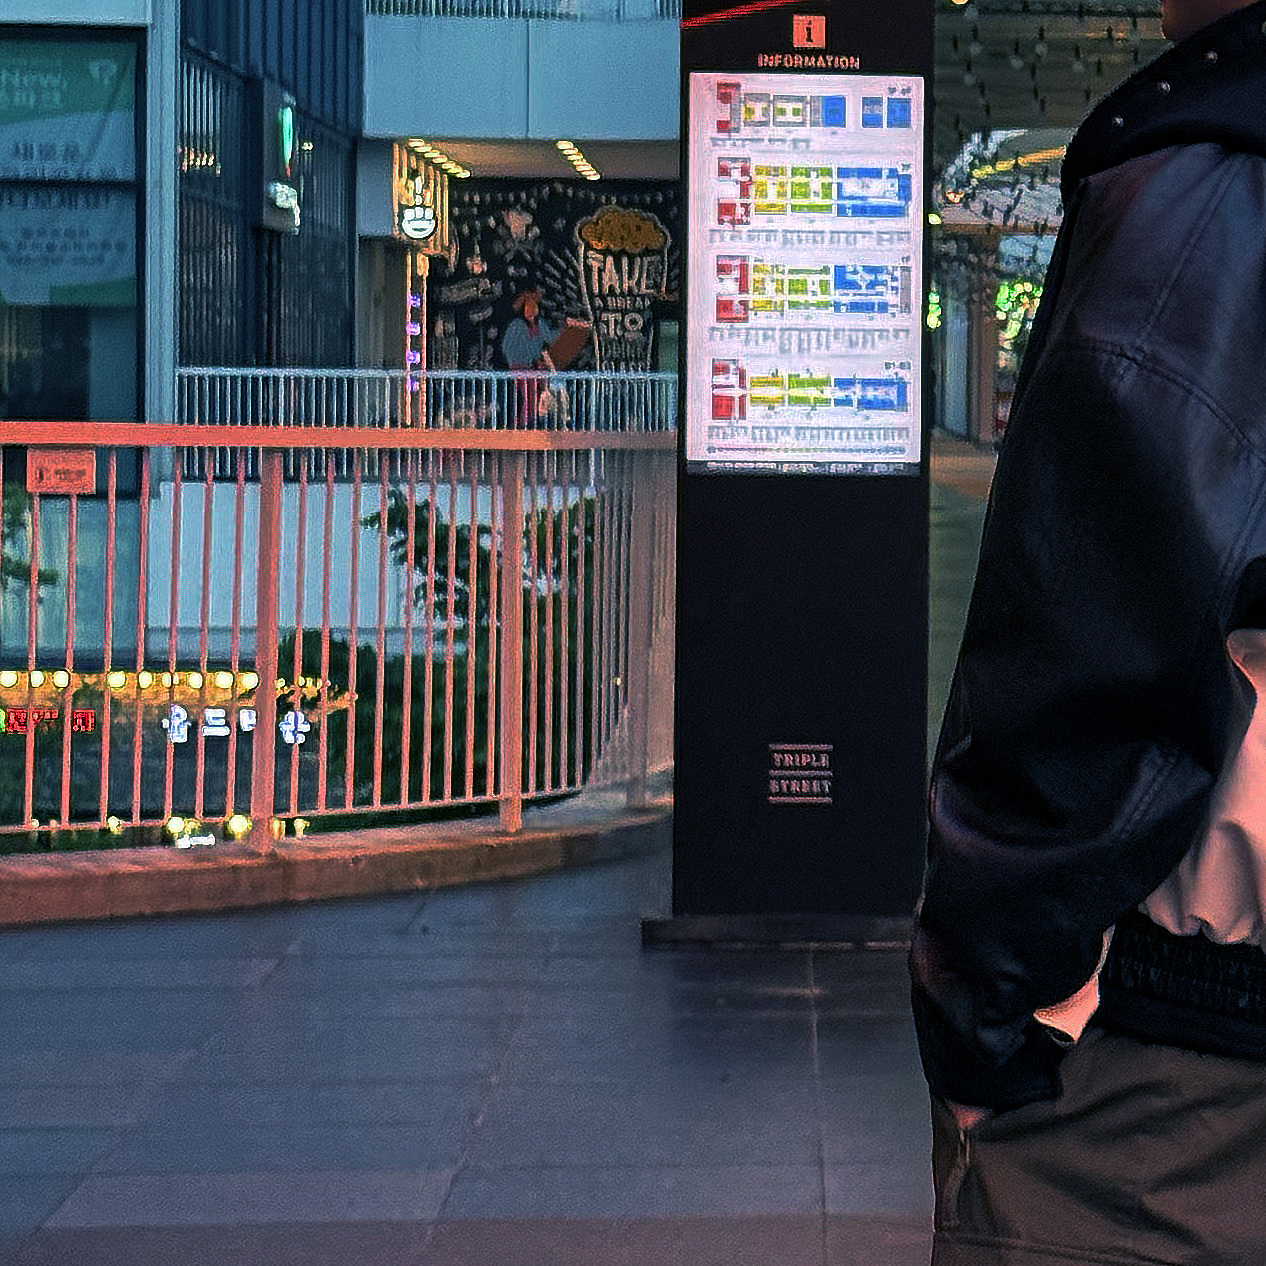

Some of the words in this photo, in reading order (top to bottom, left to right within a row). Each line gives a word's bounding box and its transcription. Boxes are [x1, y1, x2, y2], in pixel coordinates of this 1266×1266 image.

[757, 53, 860, 70] INFORMATION
[586, 250, 663, 297] TAKE
[773, 752, 830, 768] TRIPLE
[769, 779, 832, 793] STREET
